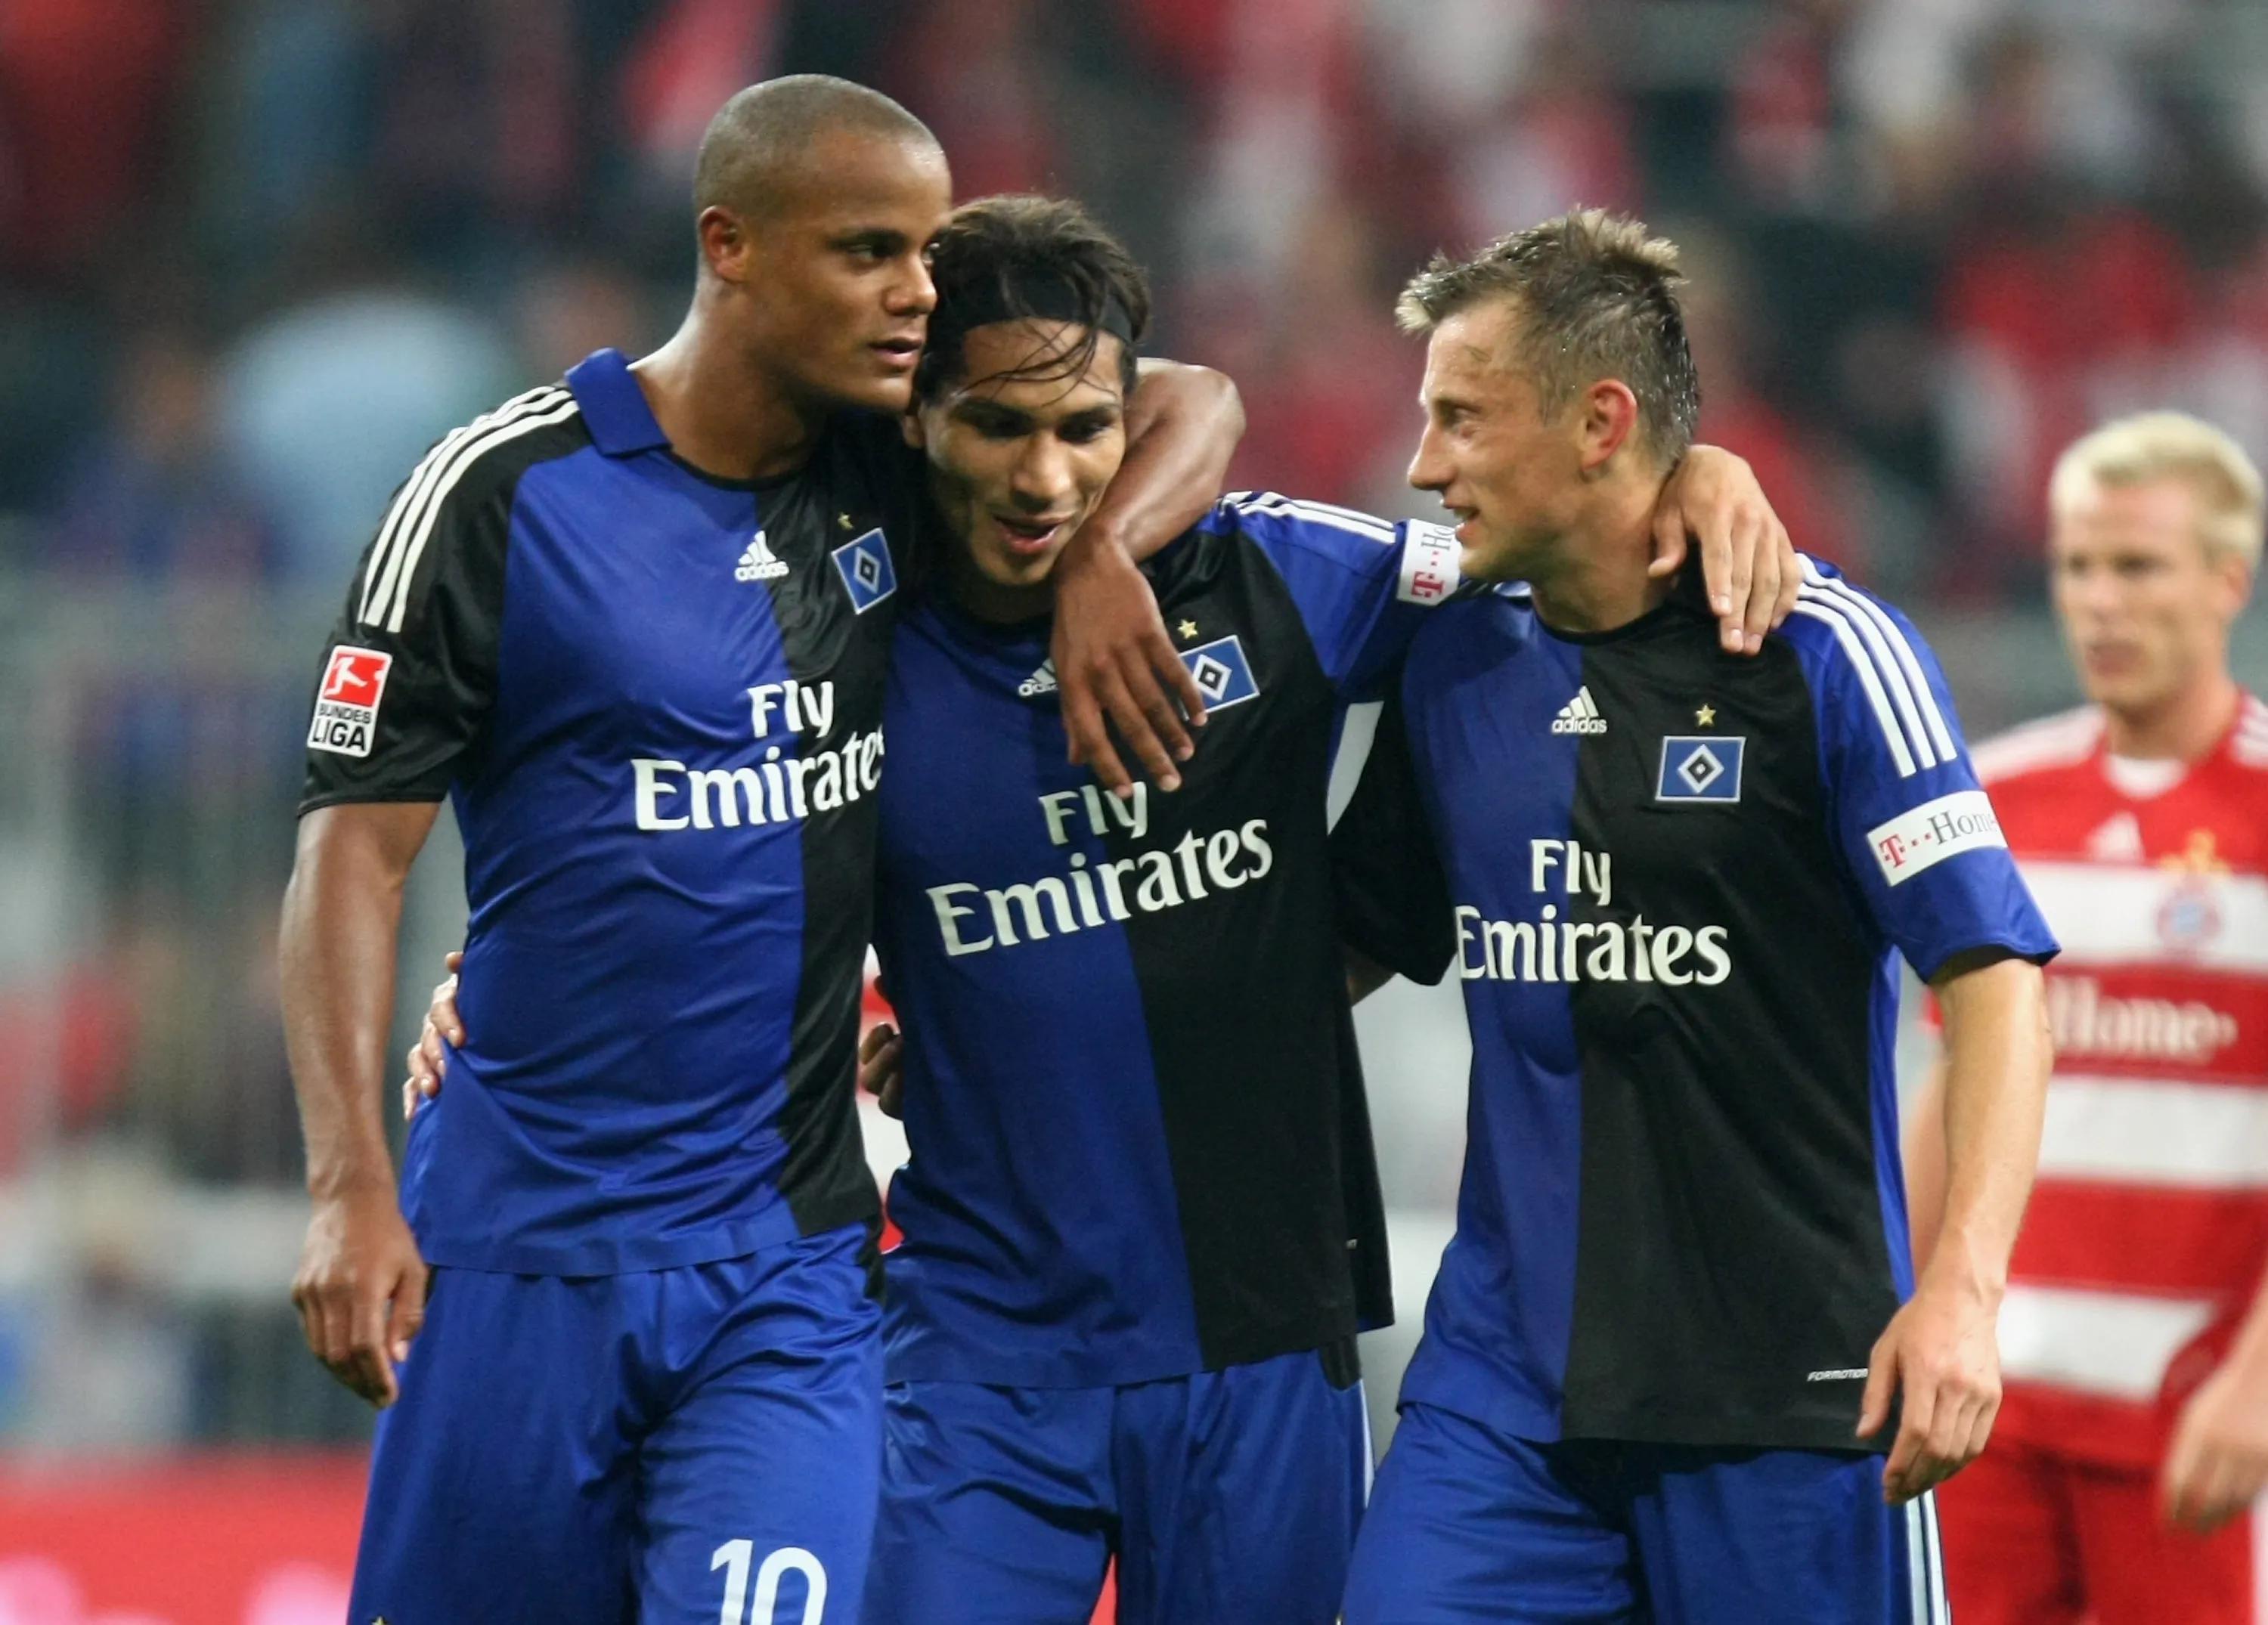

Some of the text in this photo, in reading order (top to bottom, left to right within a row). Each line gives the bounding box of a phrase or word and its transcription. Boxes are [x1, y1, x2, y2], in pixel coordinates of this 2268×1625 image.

[734, 561, 790, 581] adidas
[312, 718, 367, 752] LIGA
[319, 703, 372, 724] BUNDES
[747, 679, 834, 738] Fly
[1551, 716, 1607, 734] adidas
[1039, 781, 1148, 845] Fly
[925, 819, 1273, 956] Emirates
[1530, 839, 1612, 906] Fly
[1455, 904, 1731, 986] Emirates
[710, 1539, 827, 1625] 10
